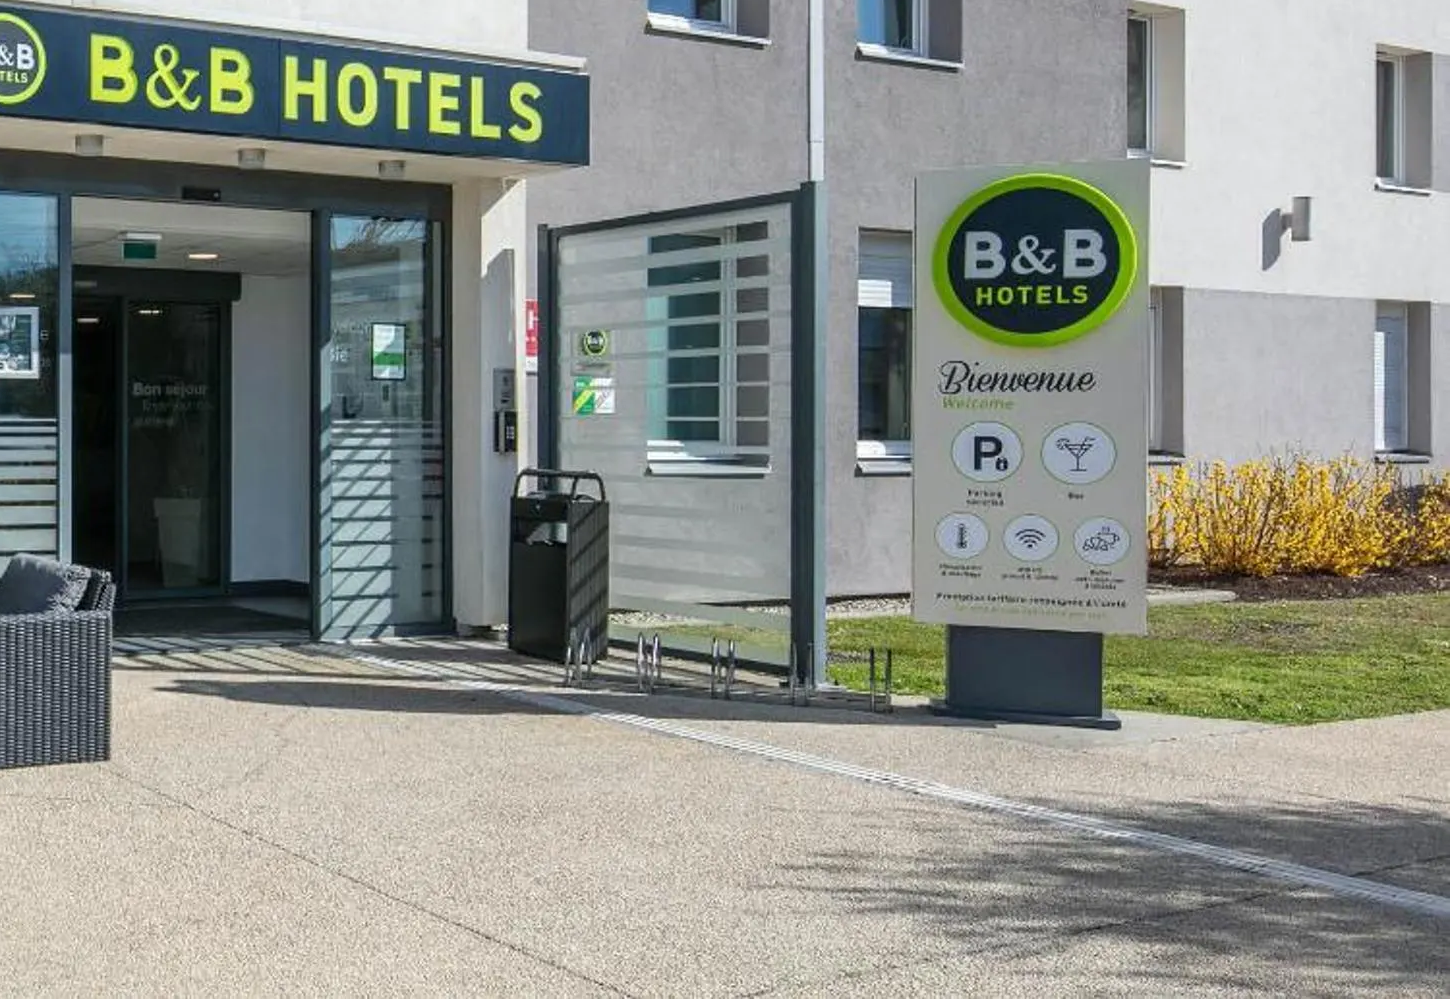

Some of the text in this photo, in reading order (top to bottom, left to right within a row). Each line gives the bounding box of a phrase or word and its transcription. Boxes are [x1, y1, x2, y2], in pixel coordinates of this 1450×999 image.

[90, 32, 544, 144] B&B HOTELS
[963, 229, 1107, 279] B&B
[975, 285, 1088, 306] HOTELS
[938, 360, 1097, 395] Bienvenue
[942, 397, 1014, 410] Welcome
